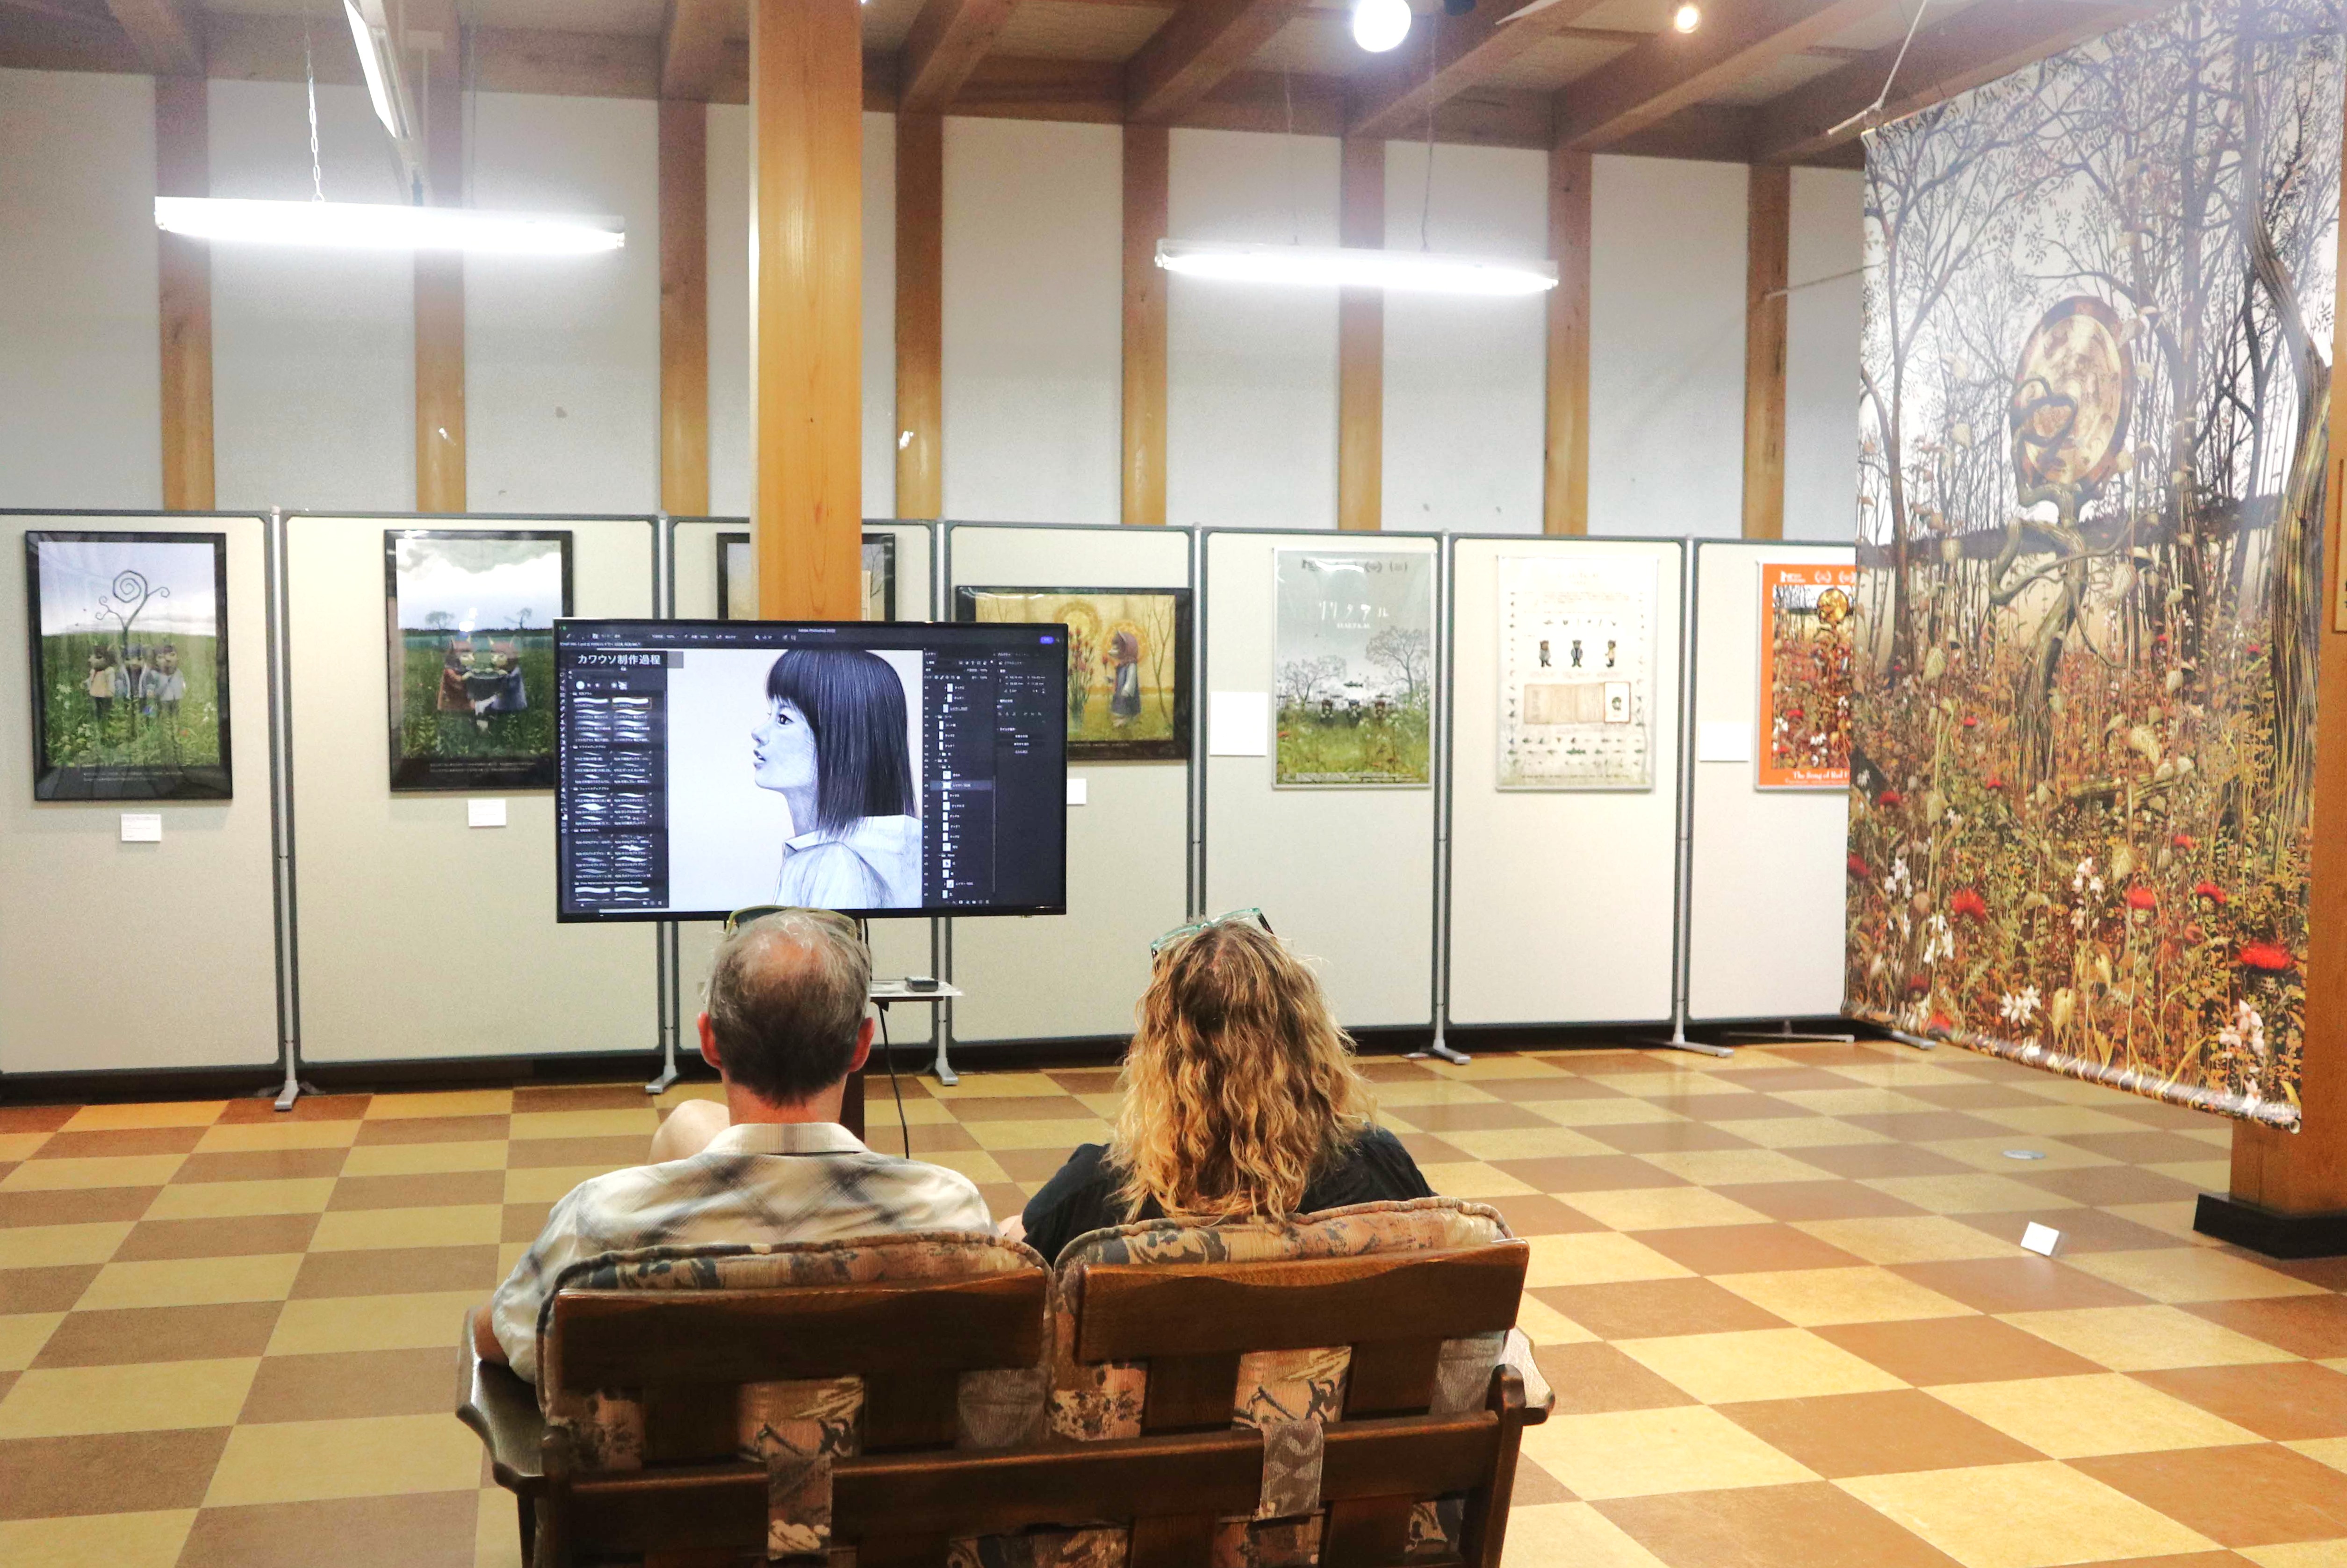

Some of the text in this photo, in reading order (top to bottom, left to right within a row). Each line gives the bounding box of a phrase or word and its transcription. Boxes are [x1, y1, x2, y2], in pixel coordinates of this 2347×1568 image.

[578, 654, 661, 665] カワウソ制作過程
